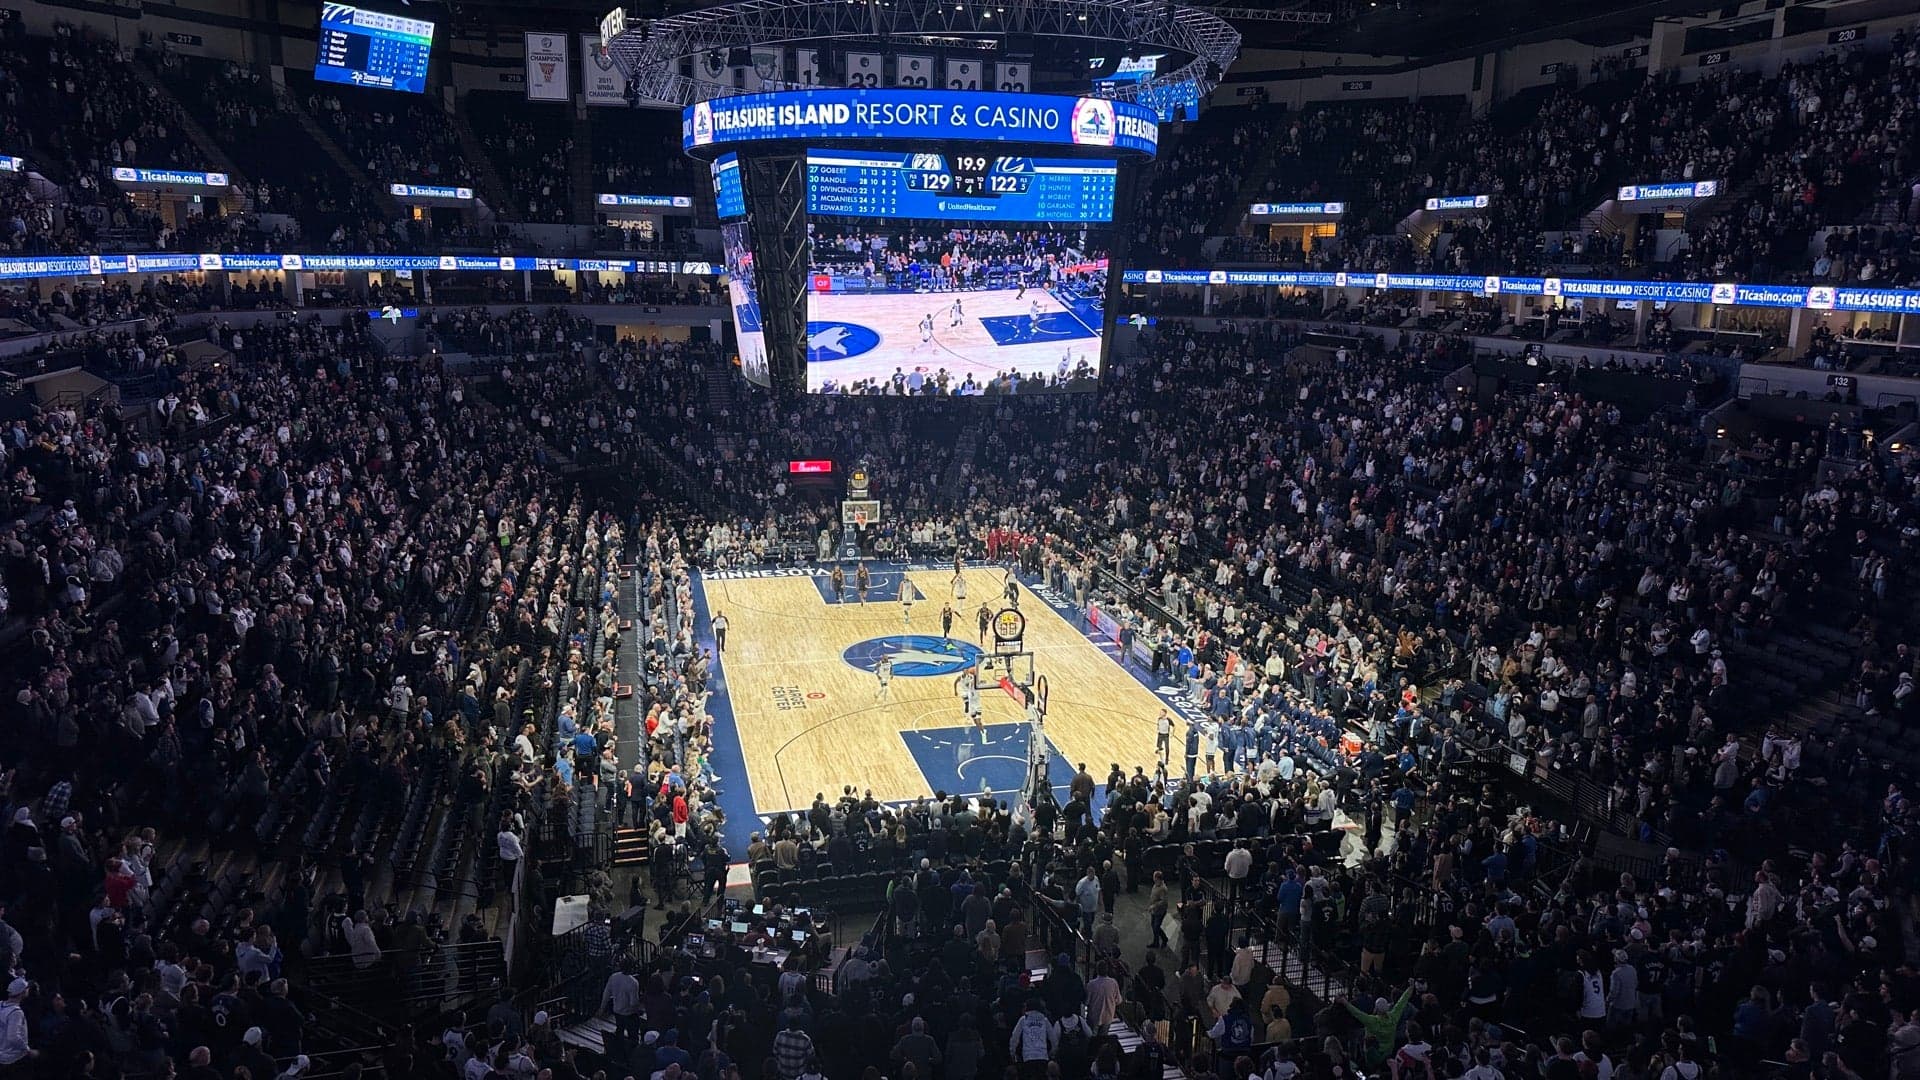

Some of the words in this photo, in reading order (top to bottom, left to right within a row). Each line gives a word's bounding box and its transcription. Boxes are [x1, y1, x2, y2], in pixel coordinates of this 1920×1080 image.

[177, 34, 192, 43] 217
[1838, 30, 1856, 42] 230
[530, 54, 564, 62] CHAMPIONS
[1706, 54, 1721, 64] 229
[713, 106, 776, 130] TREASURE
[780, 103, 849, 126] ISLAND
[856, 104, 942, 124] RESORT
[950, 104, 968, 126] &
[975, 106, 1059, 130] CASINO
[957, 157, 986, 171] 19.9
[922, 174, 950, 190] 129
[991, 177, 1016, 191] 122
[966, 185, 972, 194] 4
[947, 202, 996, 211] UnitedHealthcare
[305, 258, 346, 267] TREASURE
[348, 258, 375, 267] ISLAND
[377, 258, 403, 267] RESORT
[405, 258, 410, 267] &
[412, 258, 438, 267] CASINO
[580, 260, 606, 270] KFAN
[1415, 278, 1434, 286] ISLAND
[1461, 280, 1483, 288] CASINO
[1564, 283, 1601, 294] TREASURE
[1602, 285, 1632, 294] ISLAND
[1634, 285, 1664, 296] RESORT
[1666, 286, 1674, 297] &
[1675, 286, 1709, 298] CASINO
[1839, 293, 1903, 307] TREASURE
[1834, 377, 1848, 386] 132
[702, 567, 832, 580] MINNESOTA
[772, 687, 791, 710] CENTER
[786, 685, 806, 709] TARGET
[1442, 902, 1453, 912] 10
[1324, 911, 1330, 921] 5
[1592, 980, 1600, 995] 5
